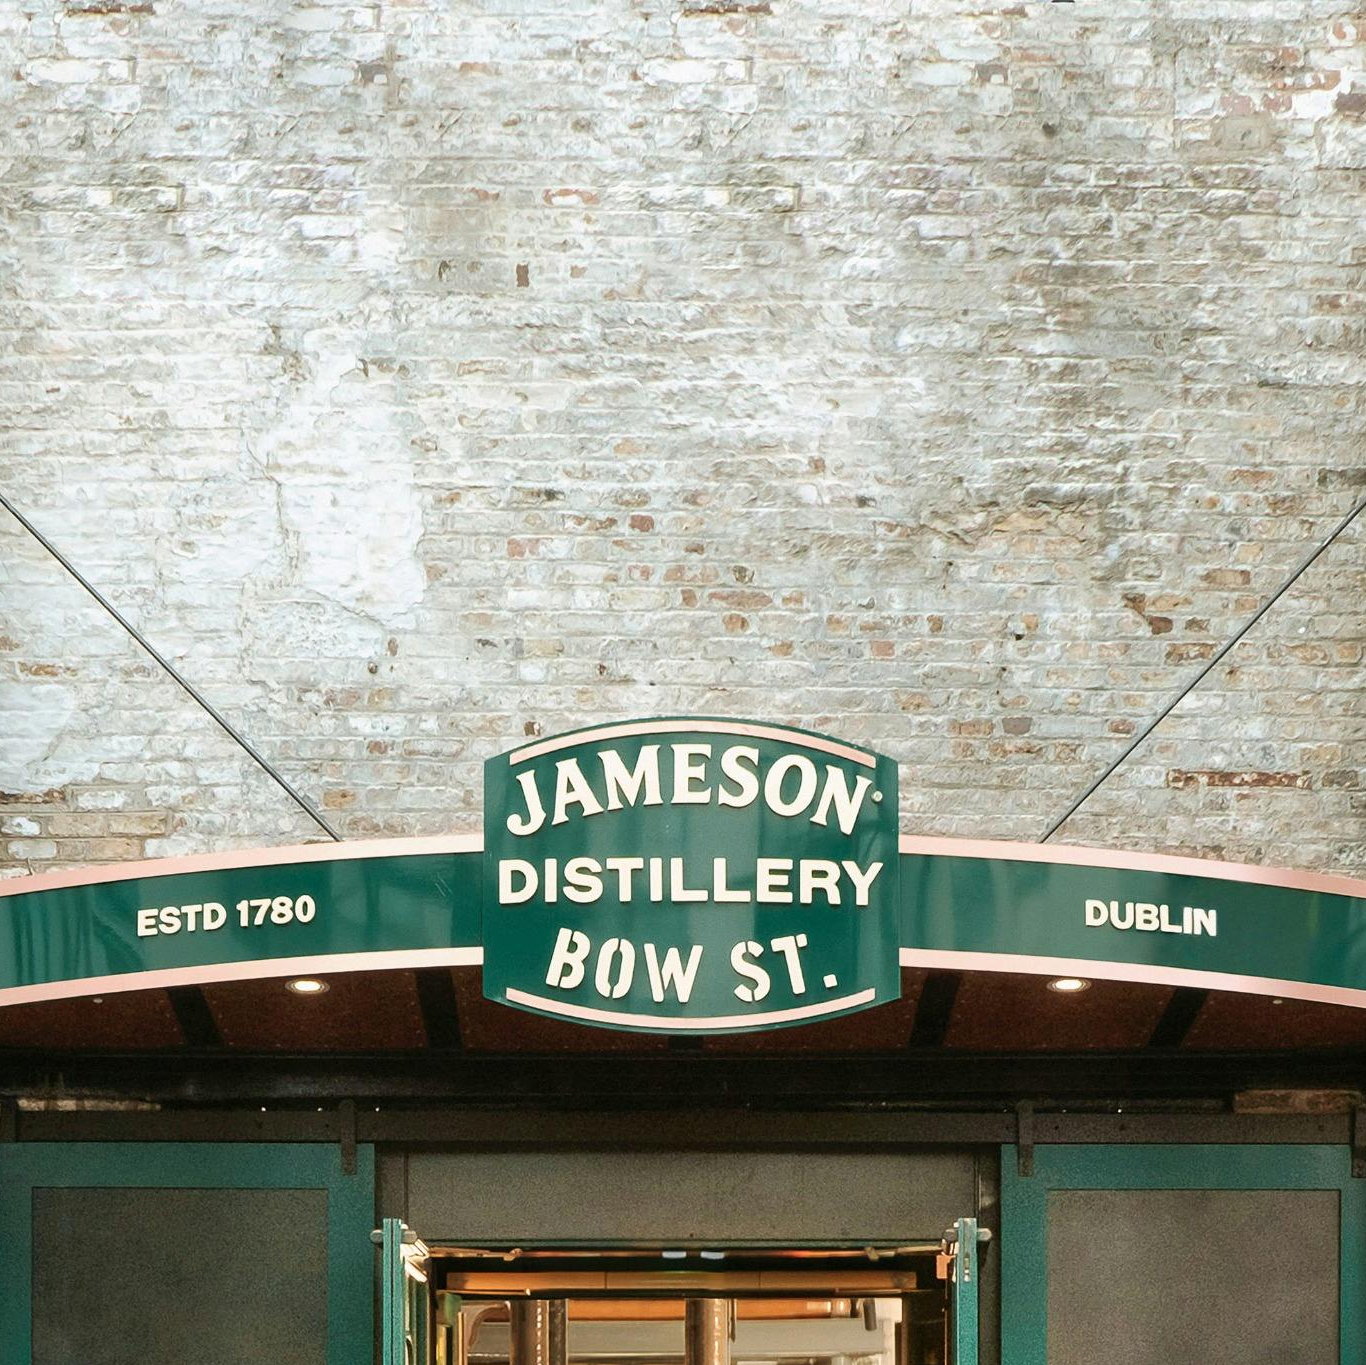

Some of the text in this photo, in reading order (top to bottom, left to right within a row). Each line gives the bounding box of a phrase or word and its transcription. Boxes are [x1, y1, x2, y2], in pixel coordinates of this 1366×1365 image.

[506, 743, 876, 836] JAMESON
[498, 857, 884, 906] DISTILLERY
[137, 894, 316, 937] ESTD 1780
[1085, 899, 1217, 937] DUBLIN
[545, 927, 838, 1004] BOW ST.
